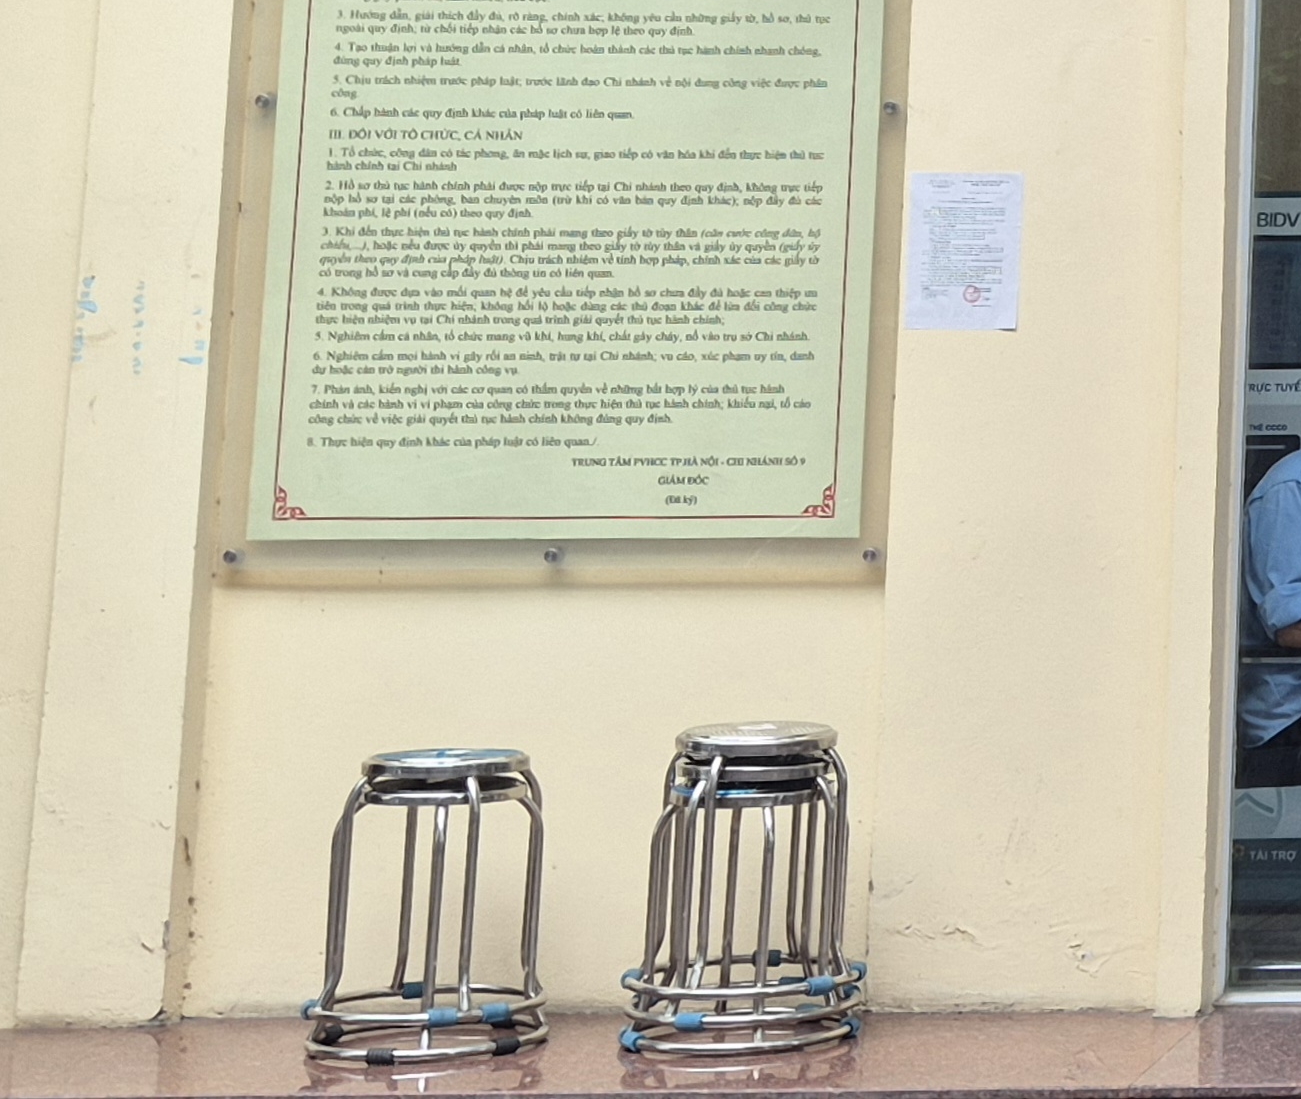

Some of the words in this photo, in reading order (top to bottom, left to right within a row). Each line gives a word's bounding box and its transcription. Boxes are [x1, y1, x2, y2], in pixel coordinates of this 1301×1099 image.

[1256, 211, 1301, 228] BIDV
[1250, 848, 1268, 860] TÀI
[1271, 850, 1297, 862] TRỢ
